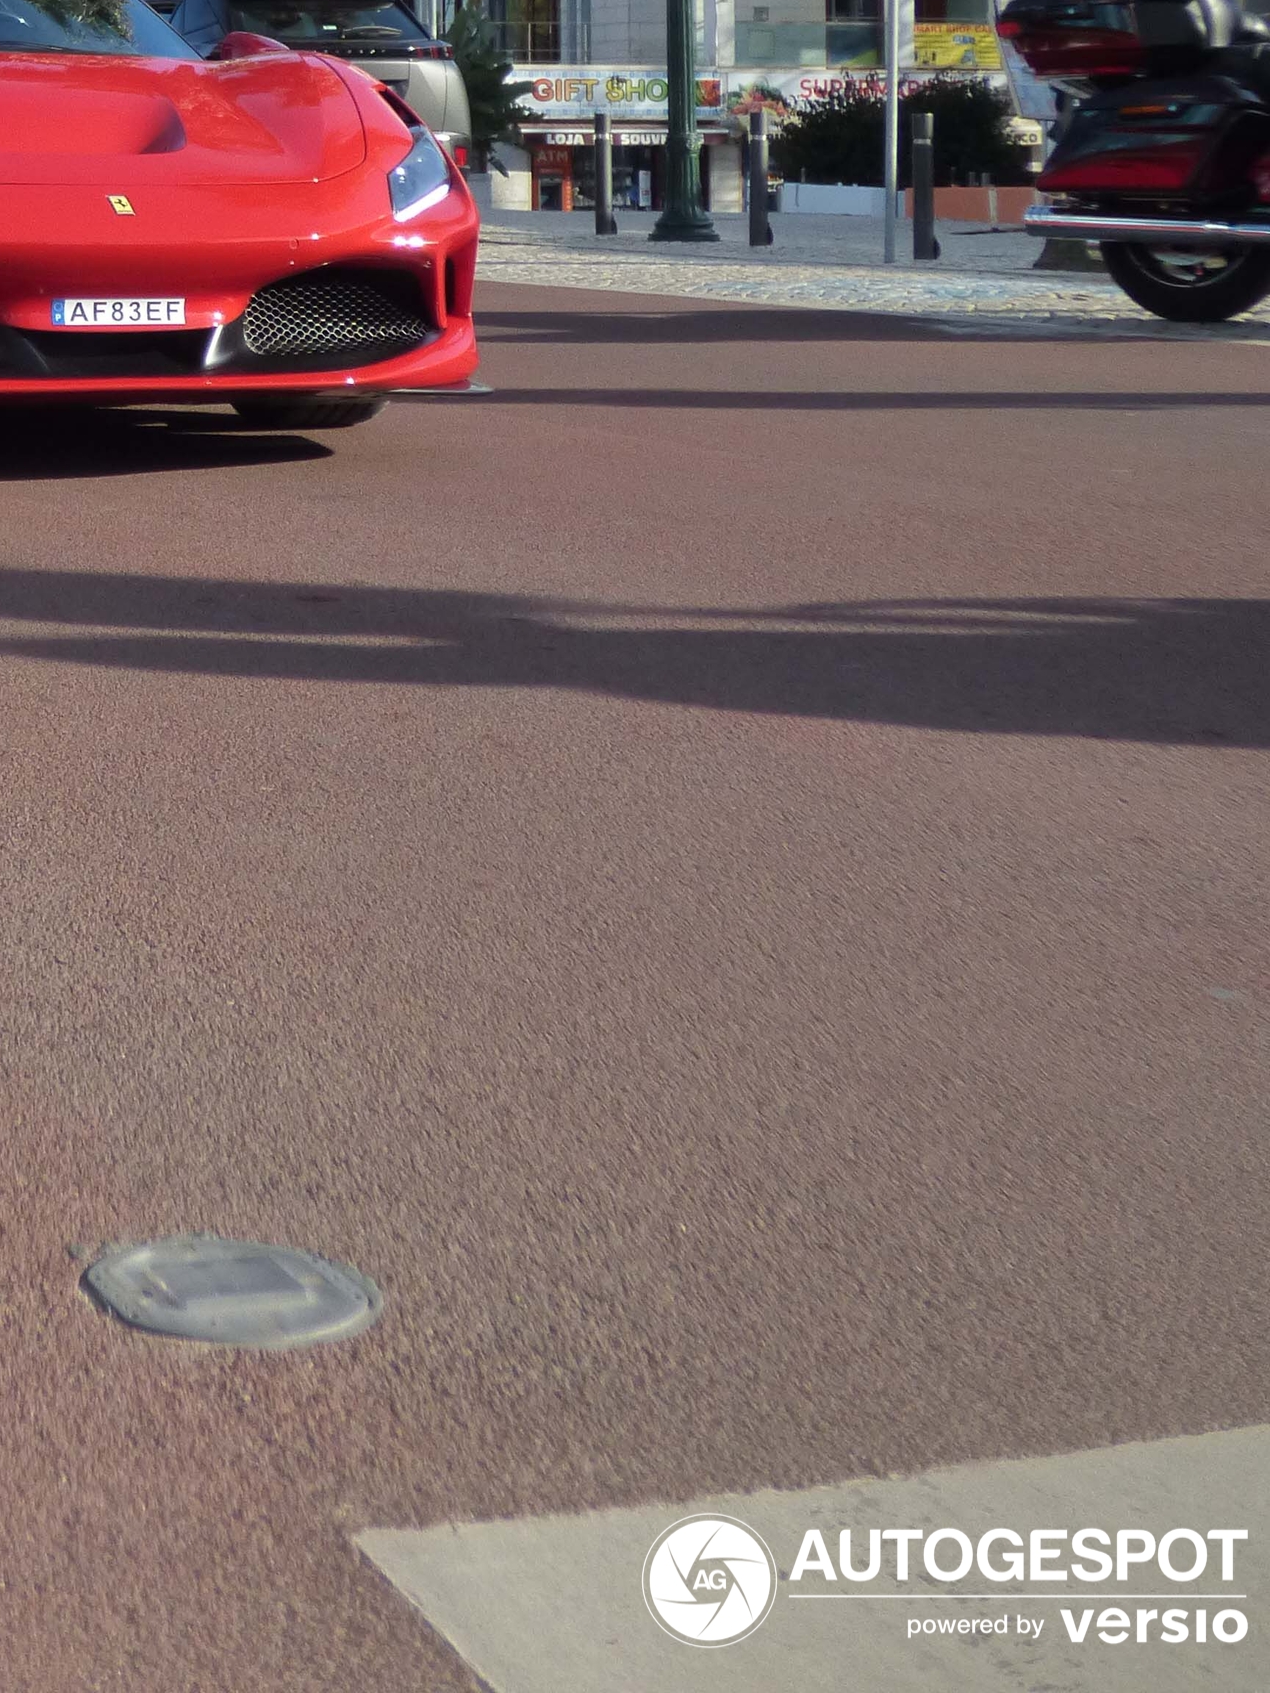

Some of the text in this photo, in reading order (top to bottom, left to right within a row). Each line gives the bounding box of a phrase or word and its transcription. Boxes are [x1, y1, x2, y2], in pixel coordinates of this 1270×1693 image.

[532, 78, 668, 102] GIFT SHO
[546, 134, 585, 145] LOJA
[537, 150, 569, 162] ATM
[70, 301, 180, 322] AF83EF
